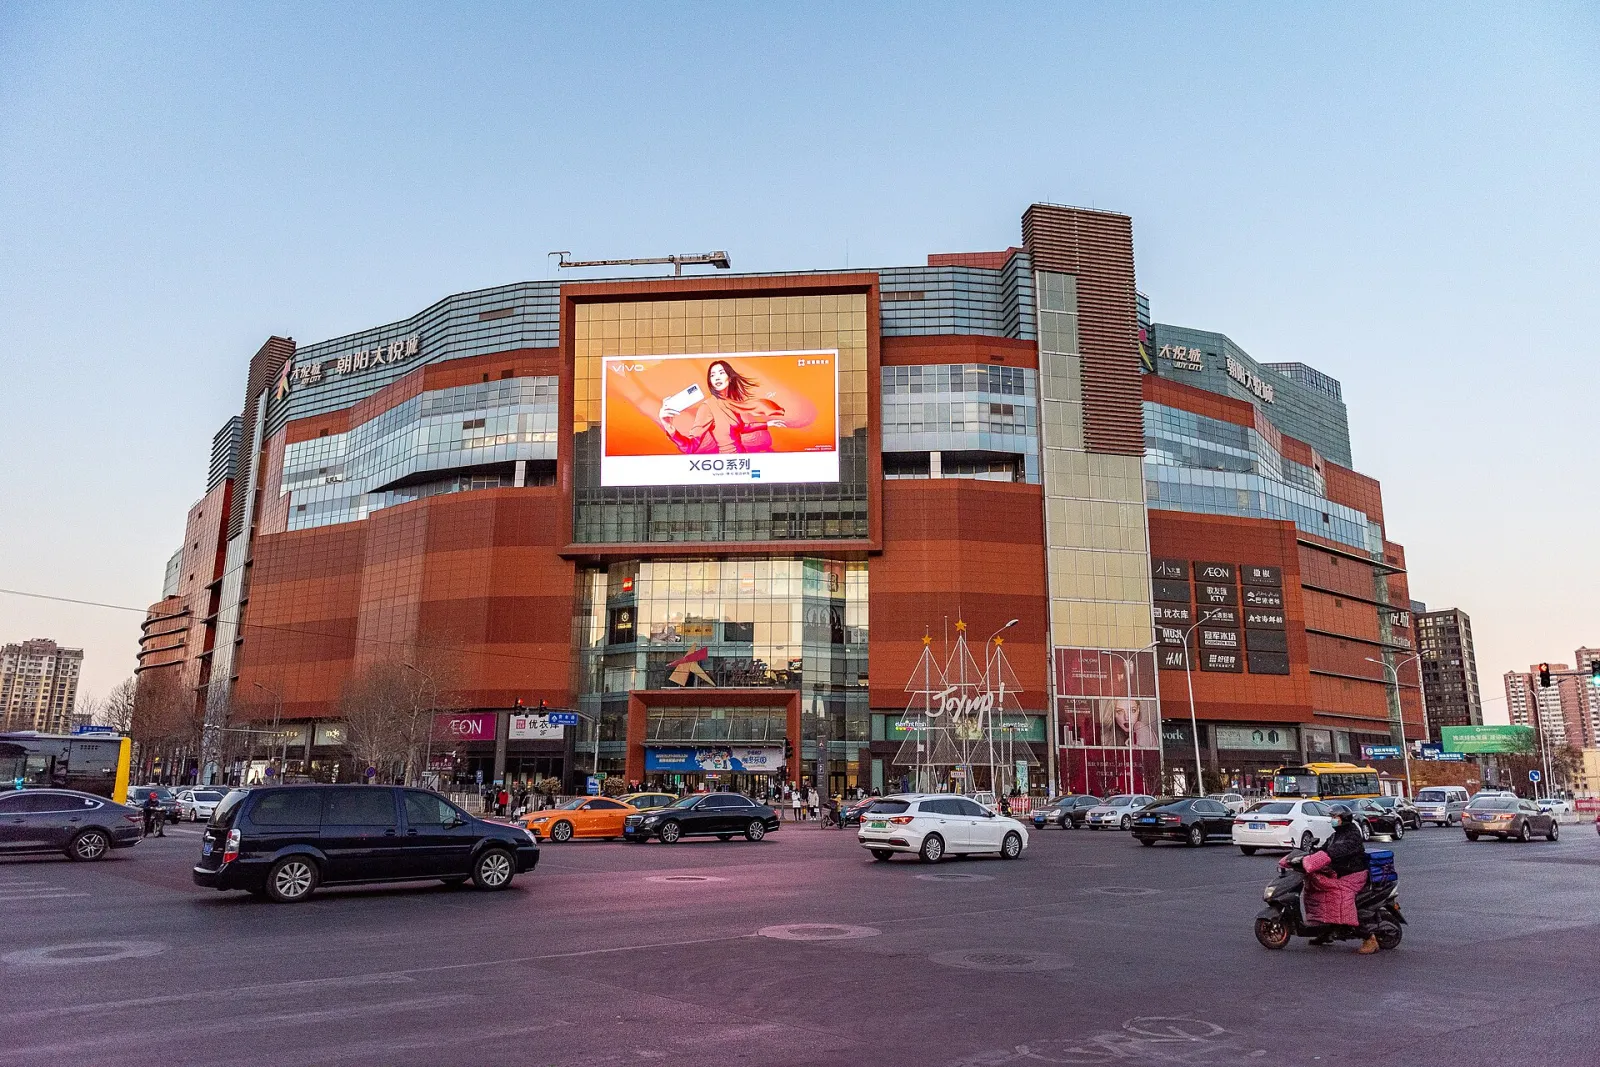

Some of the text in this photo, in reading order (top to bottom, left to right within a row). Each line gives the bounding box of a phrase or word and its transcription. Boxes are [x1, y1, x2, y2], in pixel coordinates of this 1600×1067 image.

[336, 337, 419, 374] 朝阳大悦城
[1159, 344, 1202, 362] 大悦城
[290, 362, 322, 381] 大悦城
[611, 363, 644, 372] vivo
[1189, 363, 1204, 372] CITY
[1210, 595, 1225, 603] KTV
[1163, 608, 1189, 619] 优衣库
[1165, 652, 1183, 665] H&M
